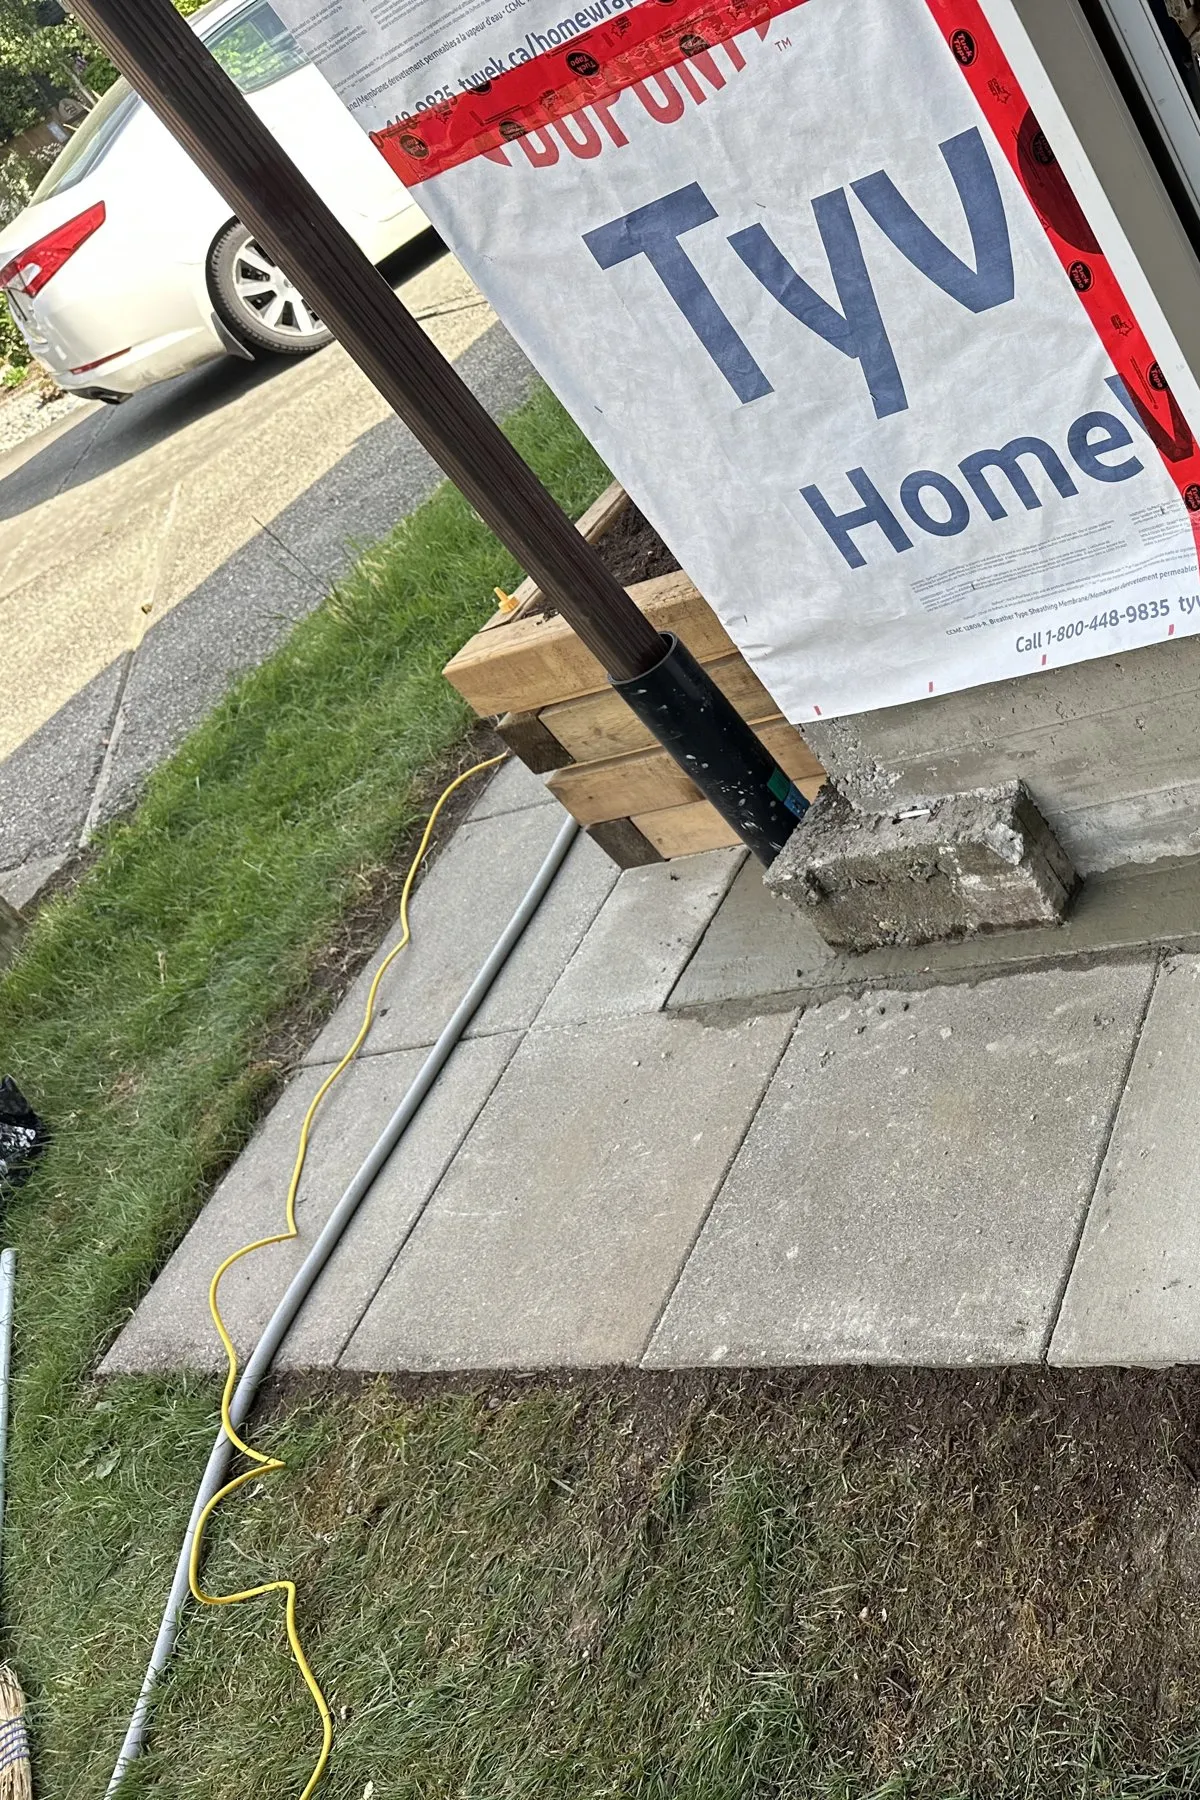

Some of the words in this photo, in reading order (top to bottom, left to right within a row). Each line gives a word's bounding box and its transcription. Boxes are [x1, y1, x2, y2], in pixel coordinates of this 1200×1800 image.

[988, 614, 1014, 625] Breather
[1014, 611, 1029, 620] Type
[1028, 602, 1058, 616] Sheathing
[1015, 631, 1043, 653] Call
[1045, 598, 1171, 646] 1-800-448-9835
